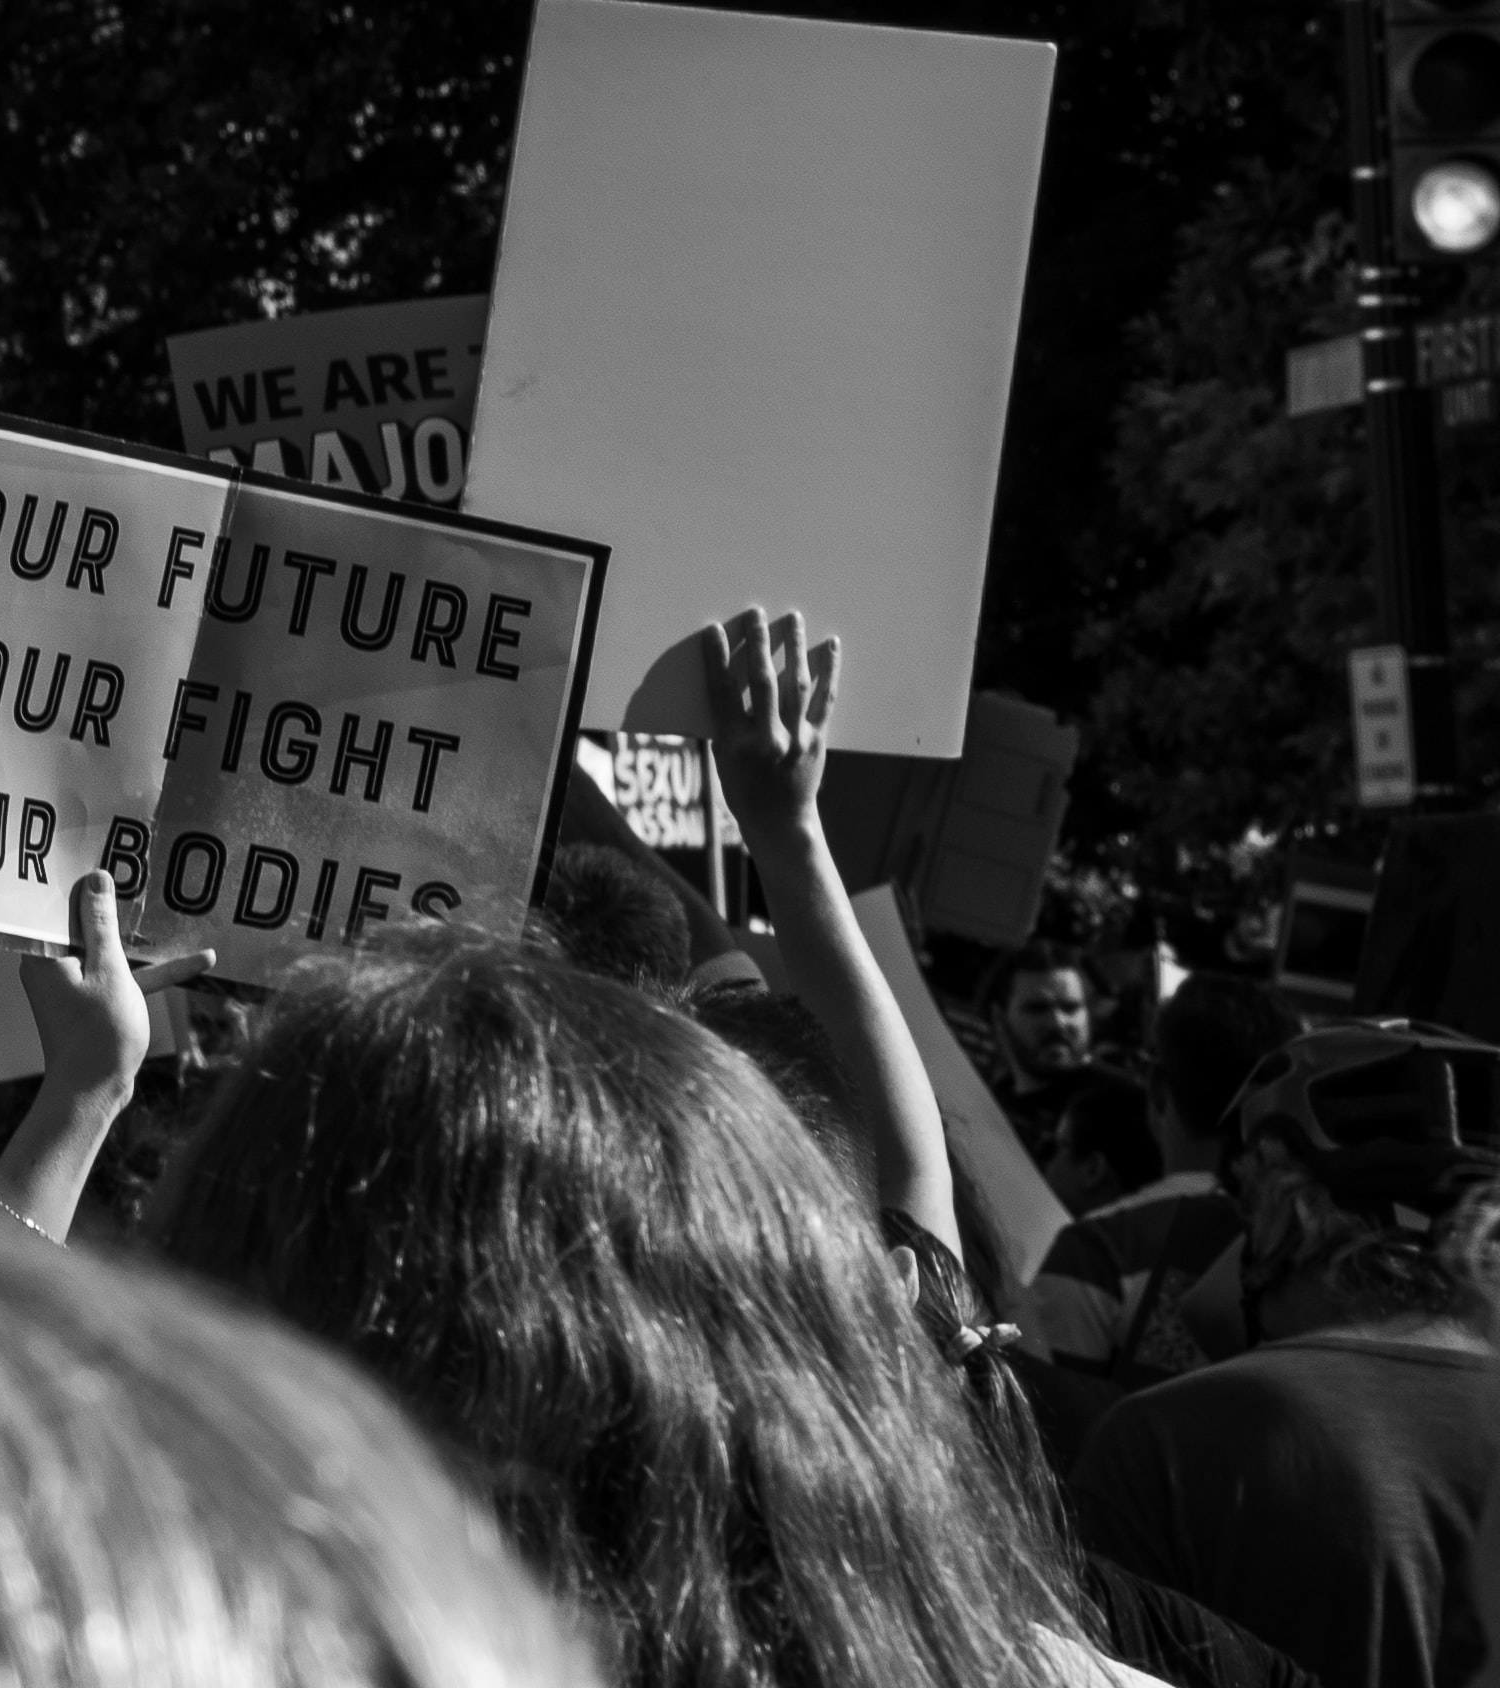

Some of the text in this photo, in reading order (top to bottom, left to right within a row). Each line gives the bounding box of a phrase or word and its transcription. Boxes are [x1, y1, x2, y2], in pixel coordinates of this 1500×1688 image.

[193, 346, 455, 431] WE ARE
[156, 526, 532, 682] FUTURE
[162, 678, 461, 814] FIGHT
